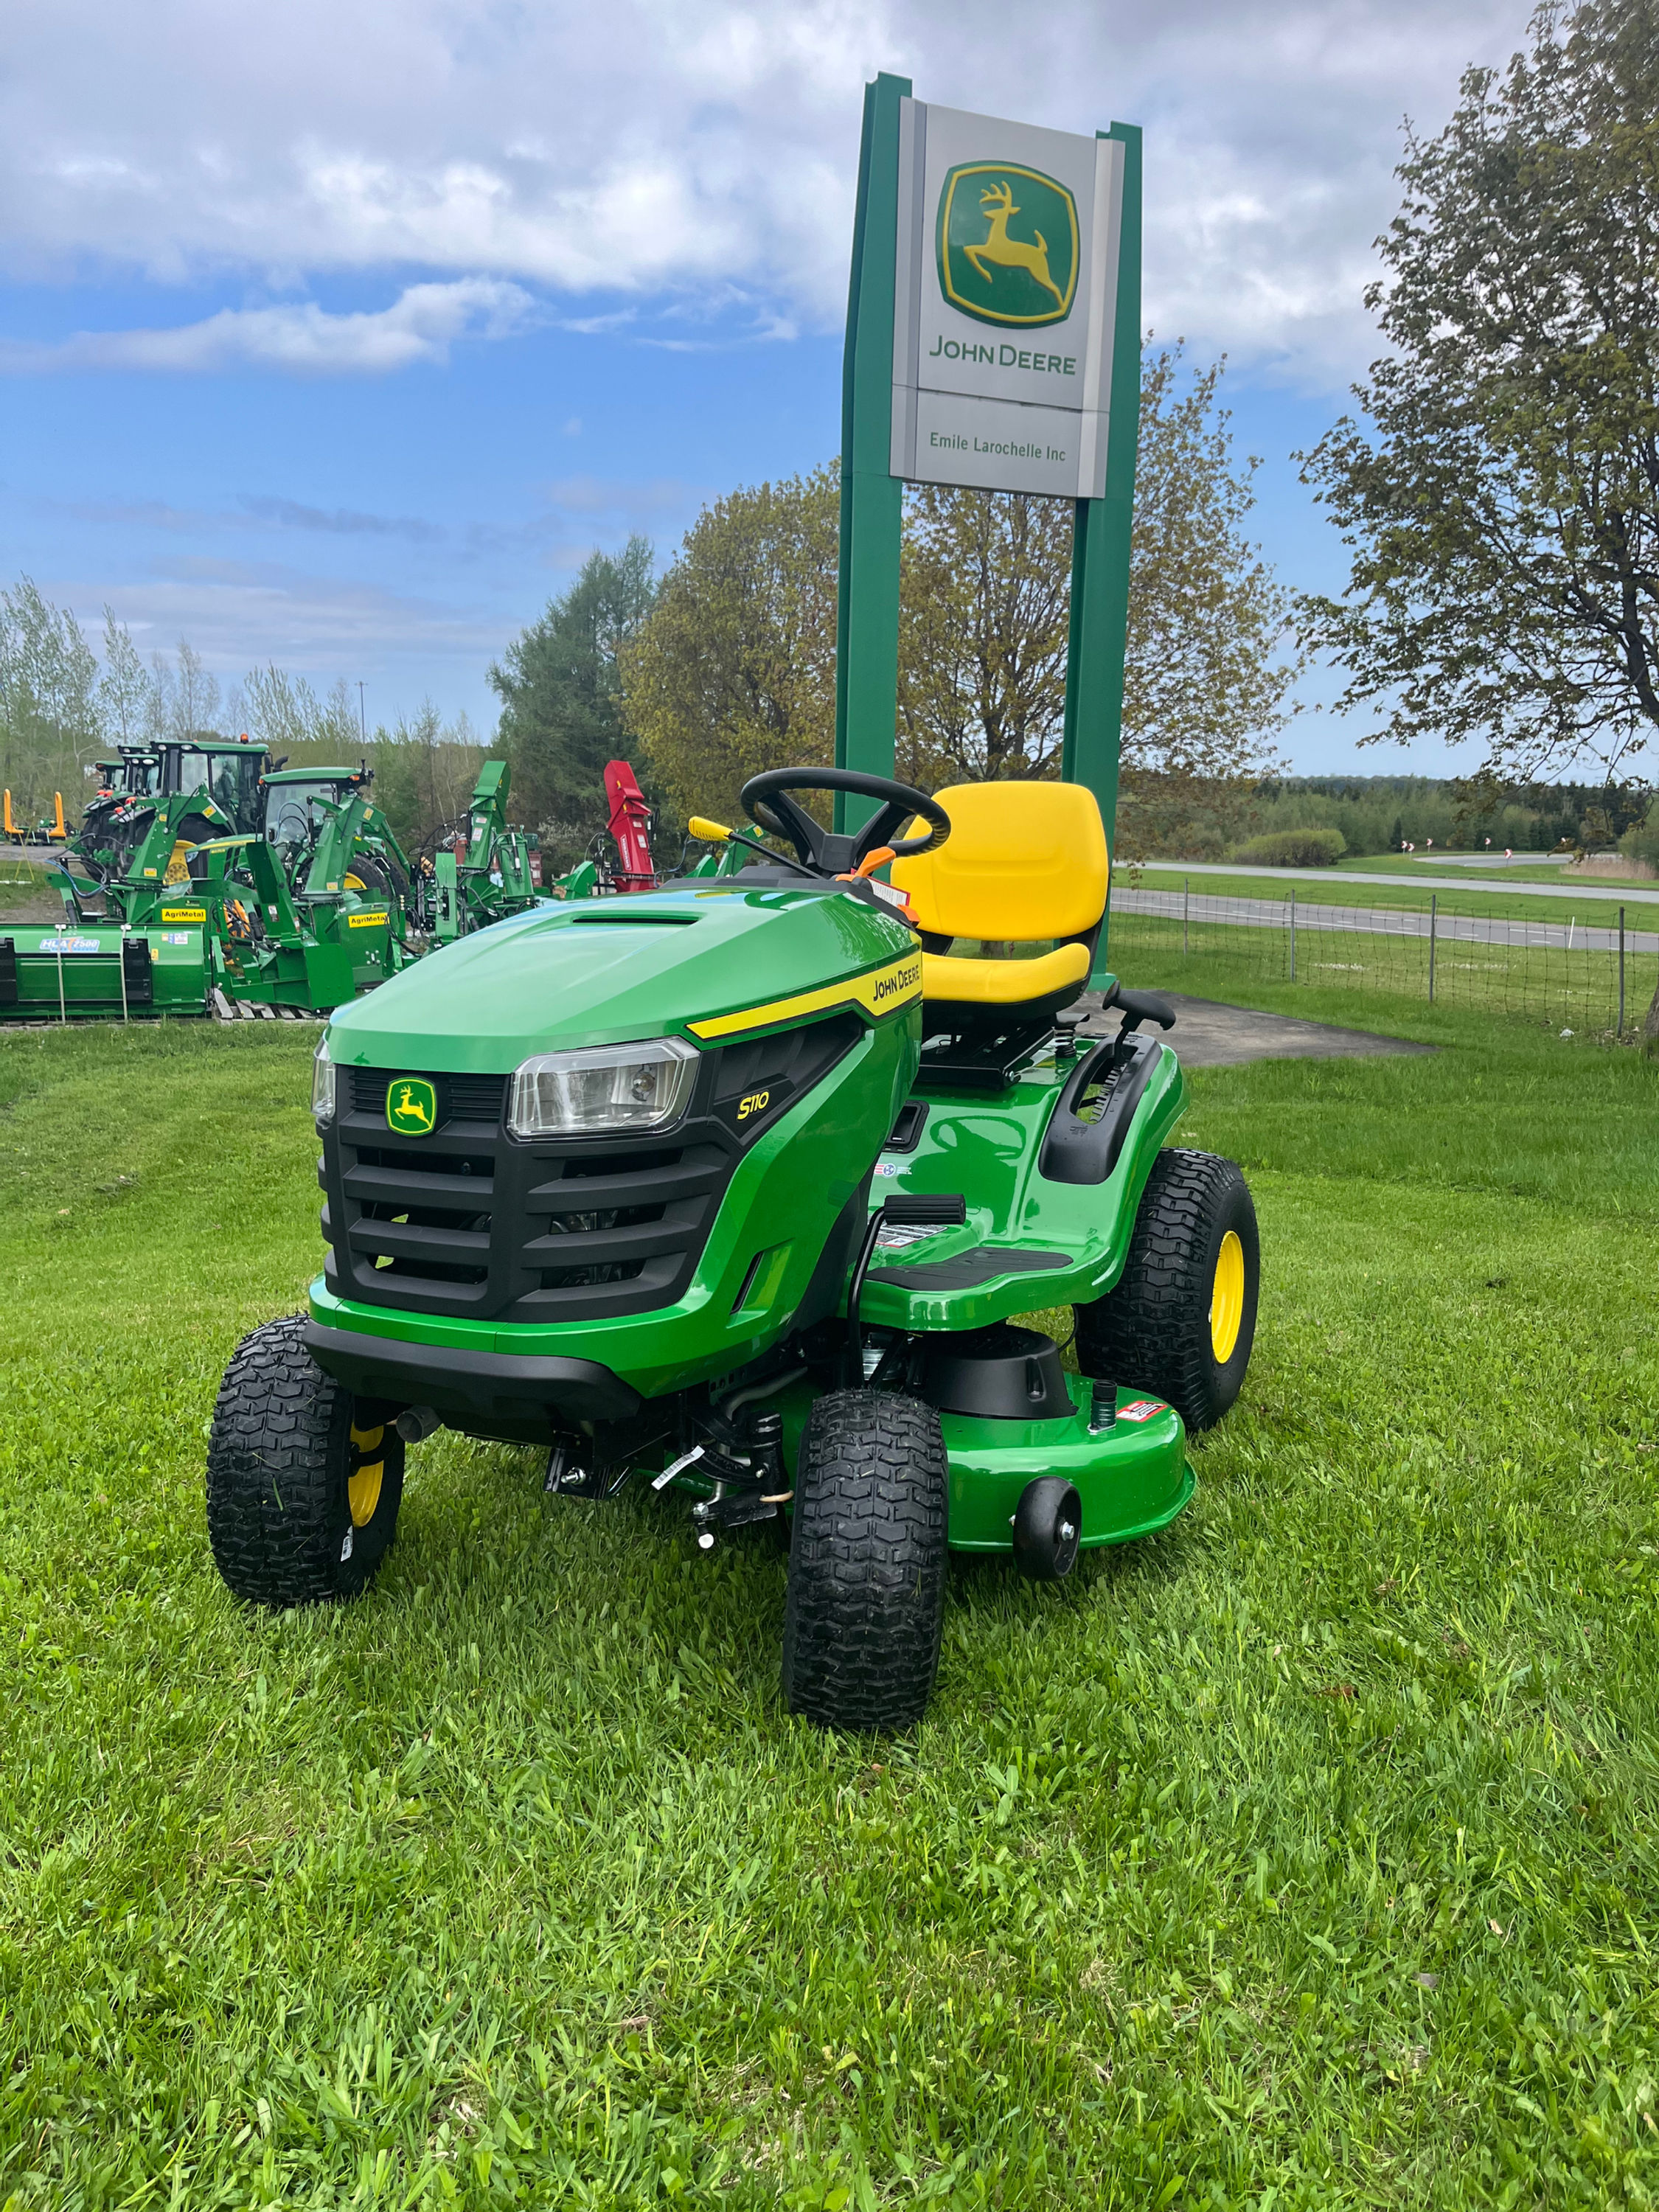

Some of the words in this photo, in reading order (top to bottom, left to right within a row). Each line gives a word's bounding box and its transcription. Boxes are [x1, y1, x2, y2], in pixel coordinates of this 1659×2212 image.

[929, 335, 994, 364] JOHN
[999, 344, 1077, 375] DEERE
[930, 432, 968, 450] Emile
[974, 437, 1042, 459] Larochelle
[1046, 445, 1066, 461] Inc
[873, 975, 897, 1001] JOHN
[897, 964, 920, 990] DEERE
[737, 1091, 769, 1119] S110
